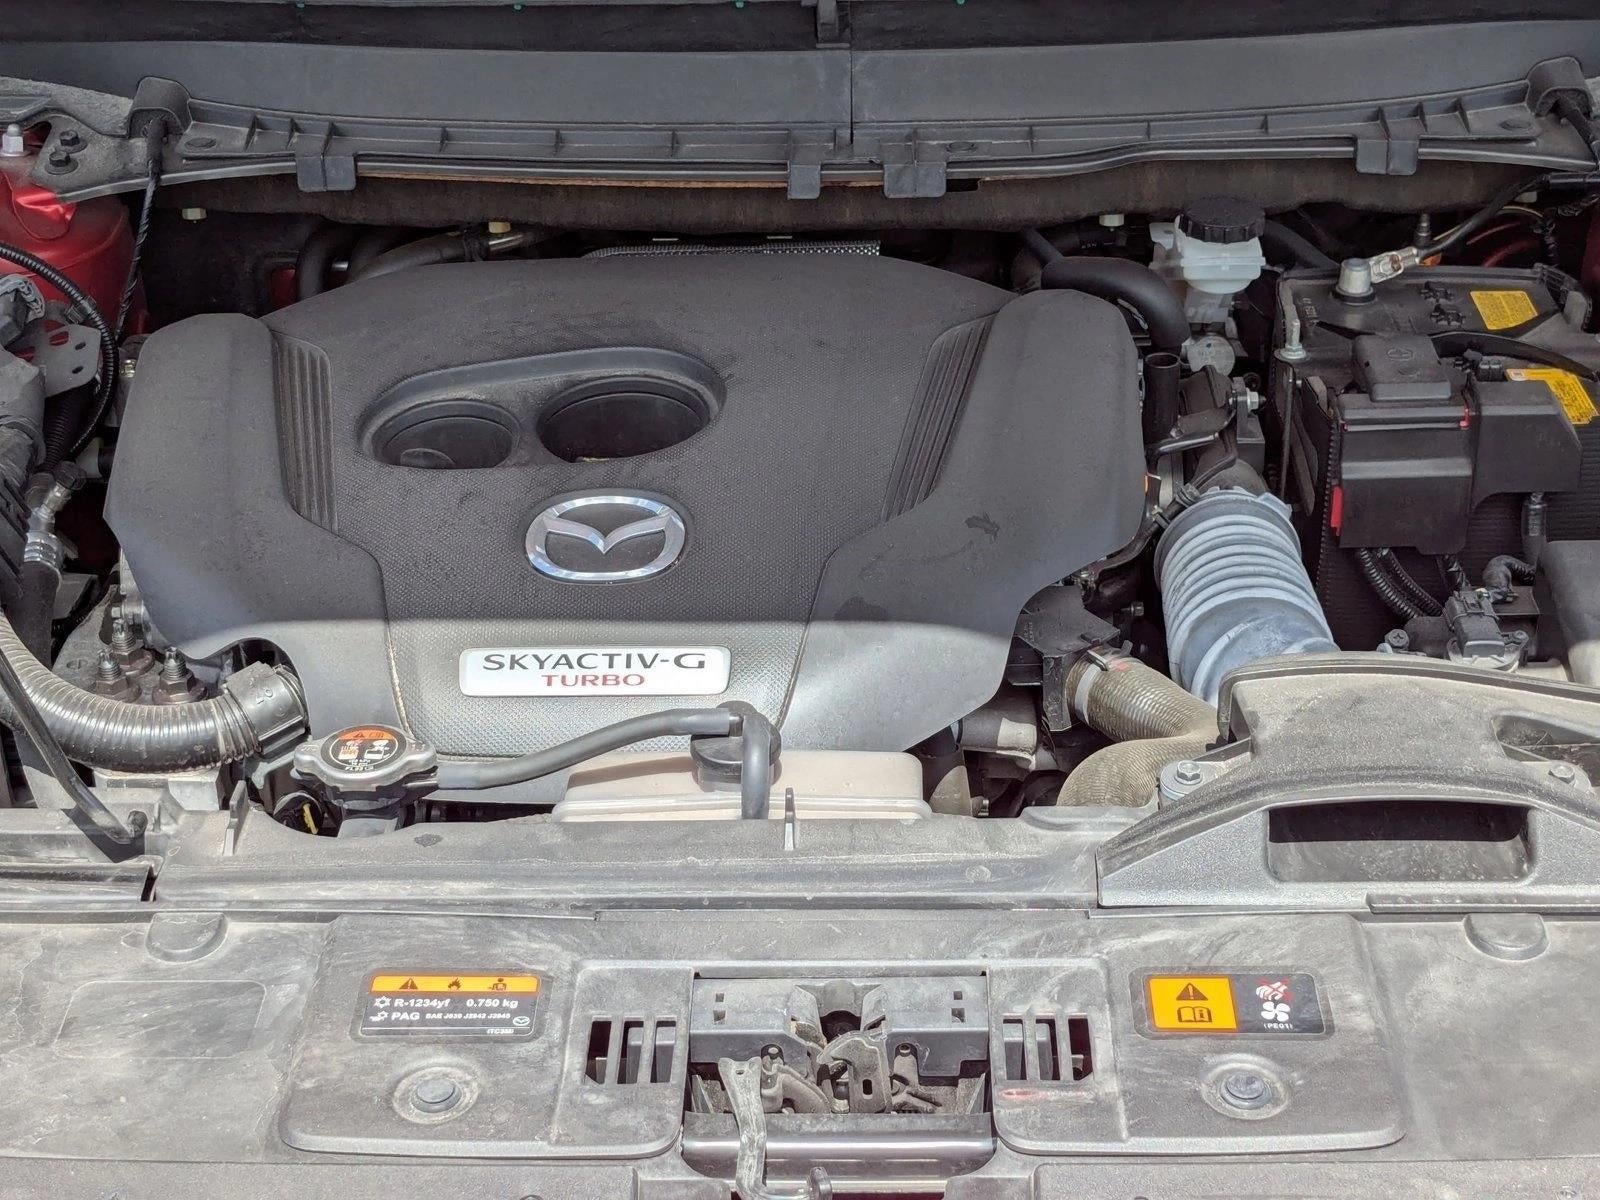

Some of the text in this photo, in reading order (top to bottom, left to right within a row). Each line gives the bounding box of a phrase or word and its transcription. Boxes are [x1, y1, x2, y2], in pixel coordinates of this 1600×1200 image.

[482, 653, 706, 670] SKYACTIV-G
[541, 674, 645, 687] TURBO
[394, 998, 519, 1009] R-1234yf 0.750 kg
[391, 1011, 420, 1020] PAG
